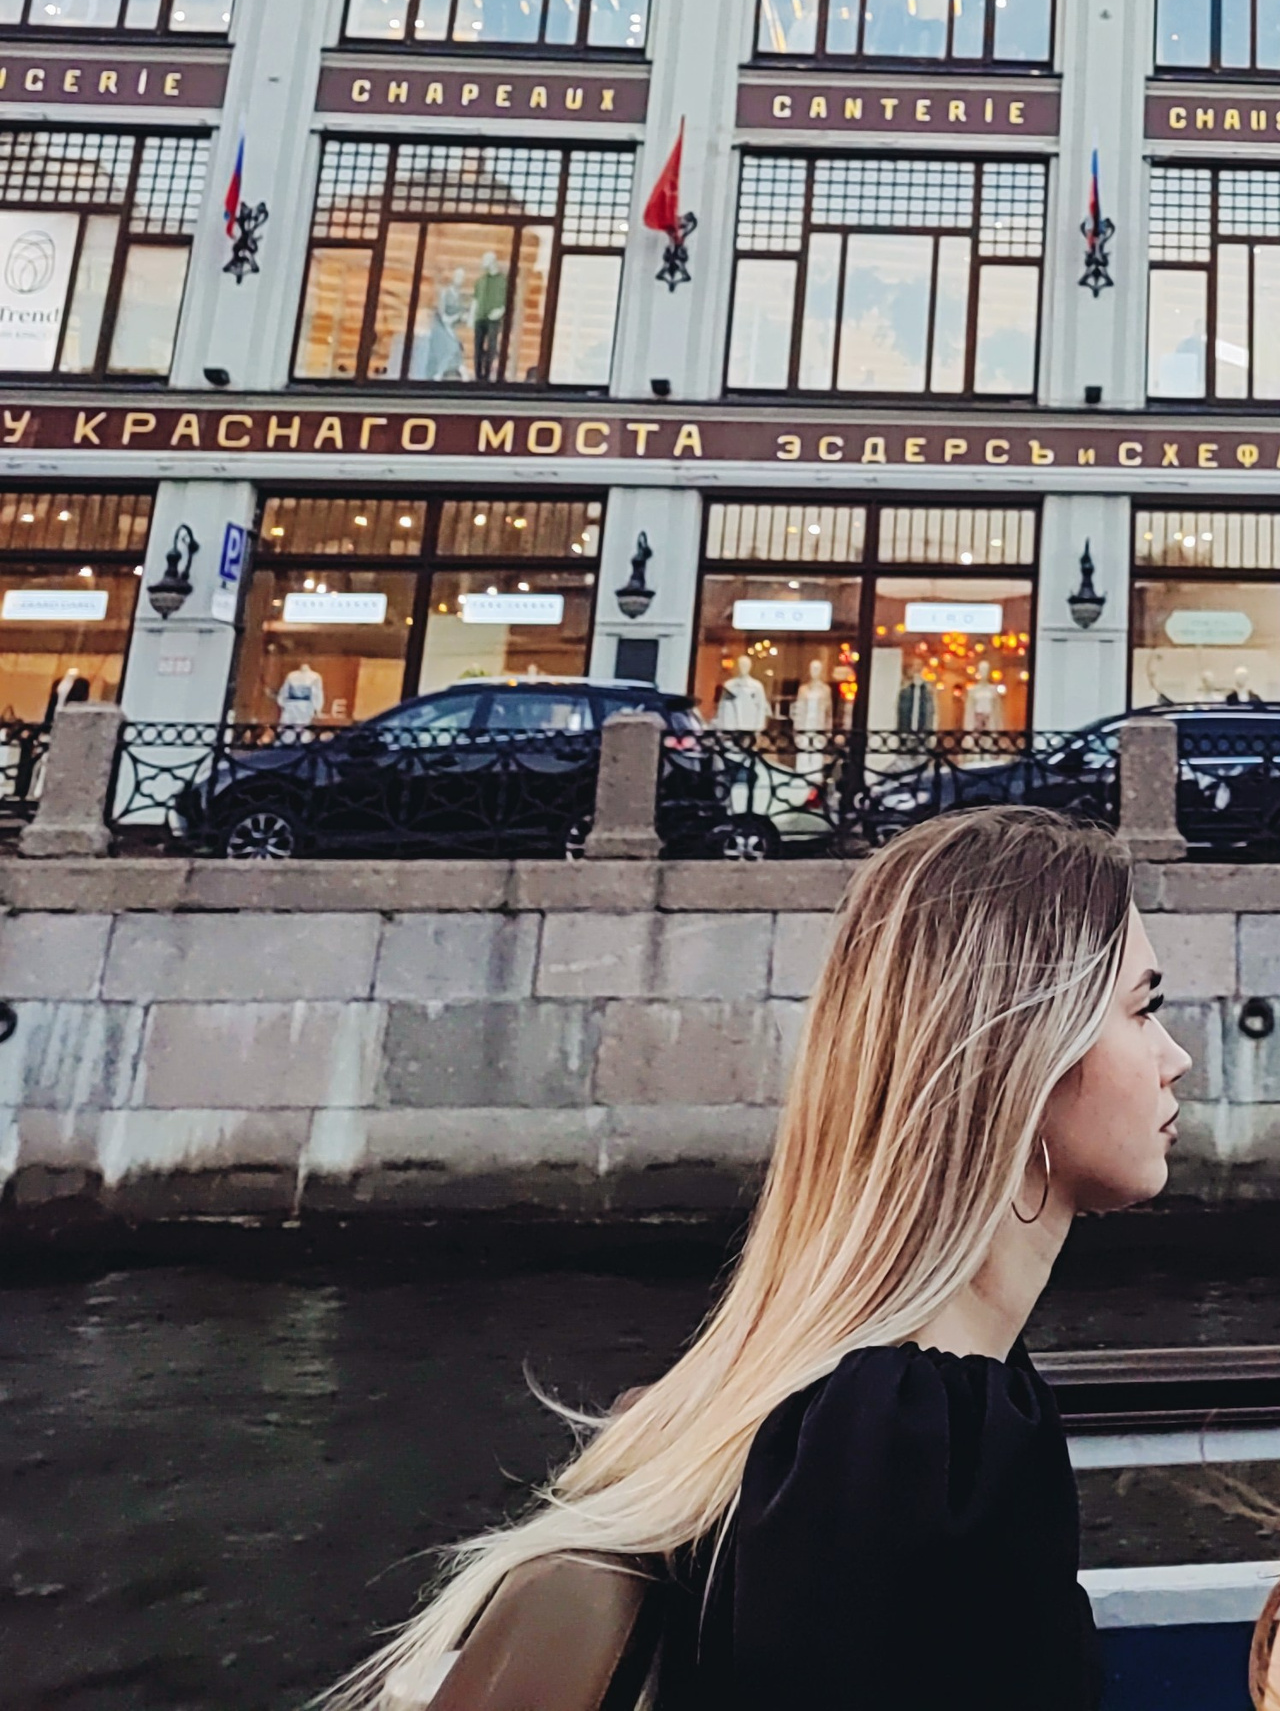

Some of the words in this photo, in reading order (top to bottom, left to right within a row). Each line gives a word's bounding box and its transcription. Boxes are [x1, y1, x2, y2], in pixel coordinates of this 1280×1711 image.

[351, 78, 615, 112] CHAPEAUX
[3, 410, 31, 443] У
[73, 410, 437, 453] КРАСНАГО
[478, 418, 704, 458] МОСТА
[776, 434, 1055, 465] ЭСДЕРСЪ
